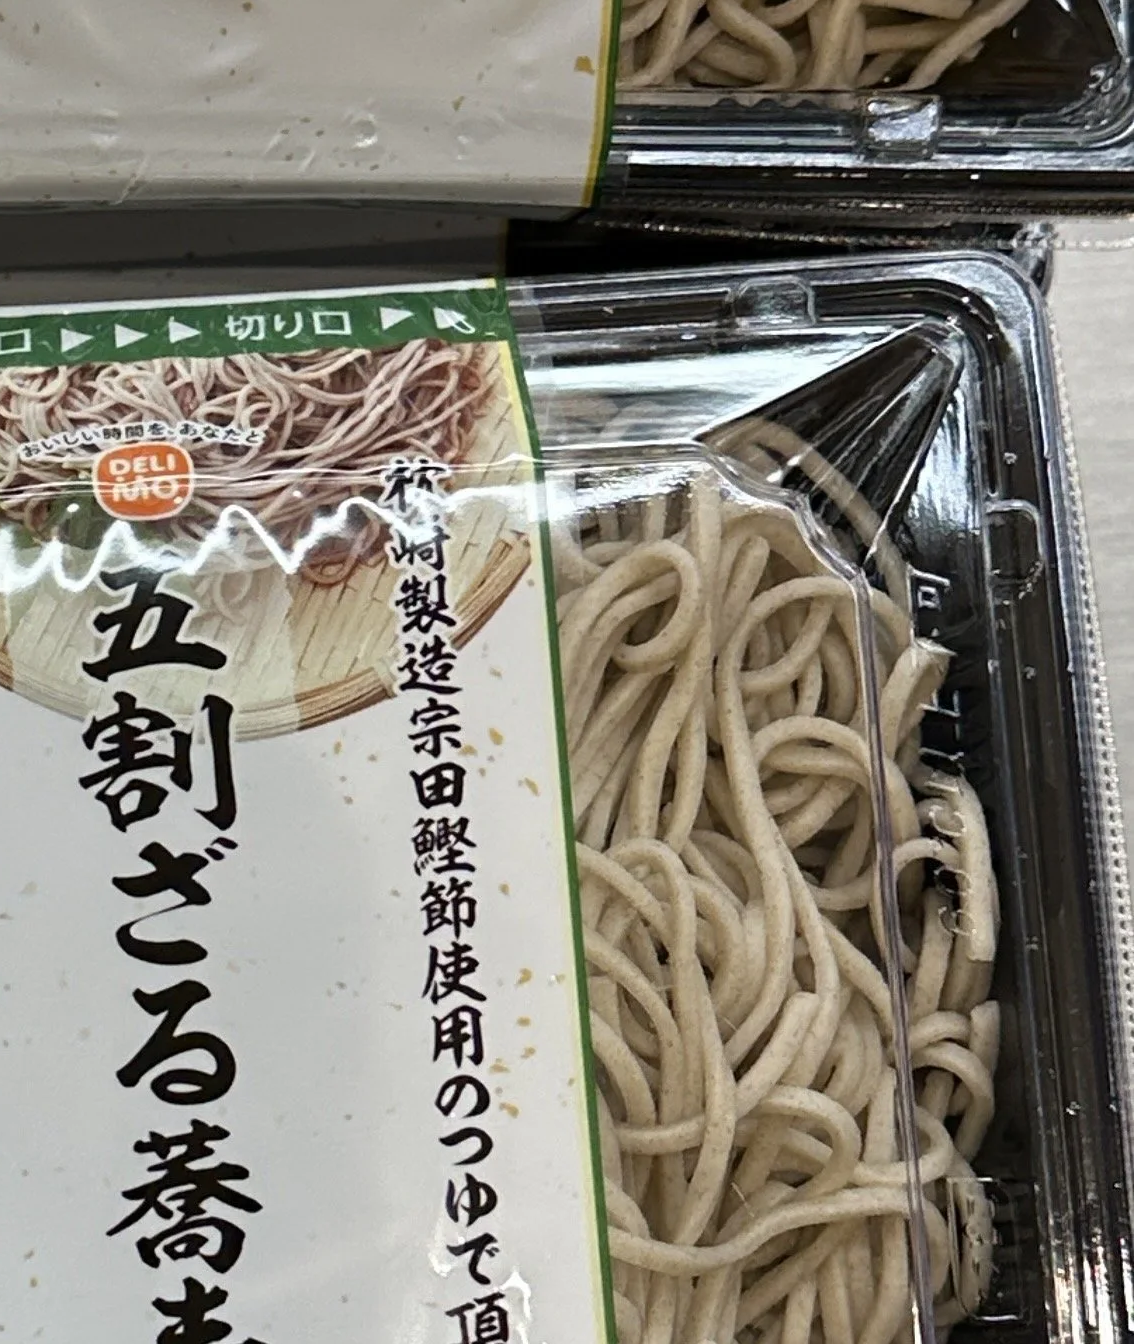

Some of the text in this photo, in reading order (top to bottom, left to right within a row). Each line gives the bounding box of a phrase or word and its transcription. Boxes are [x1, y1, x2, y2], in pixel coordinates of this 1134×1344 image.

[224, 311, 352, 342] 切り口
[109, 453, 177, 476] DELI
